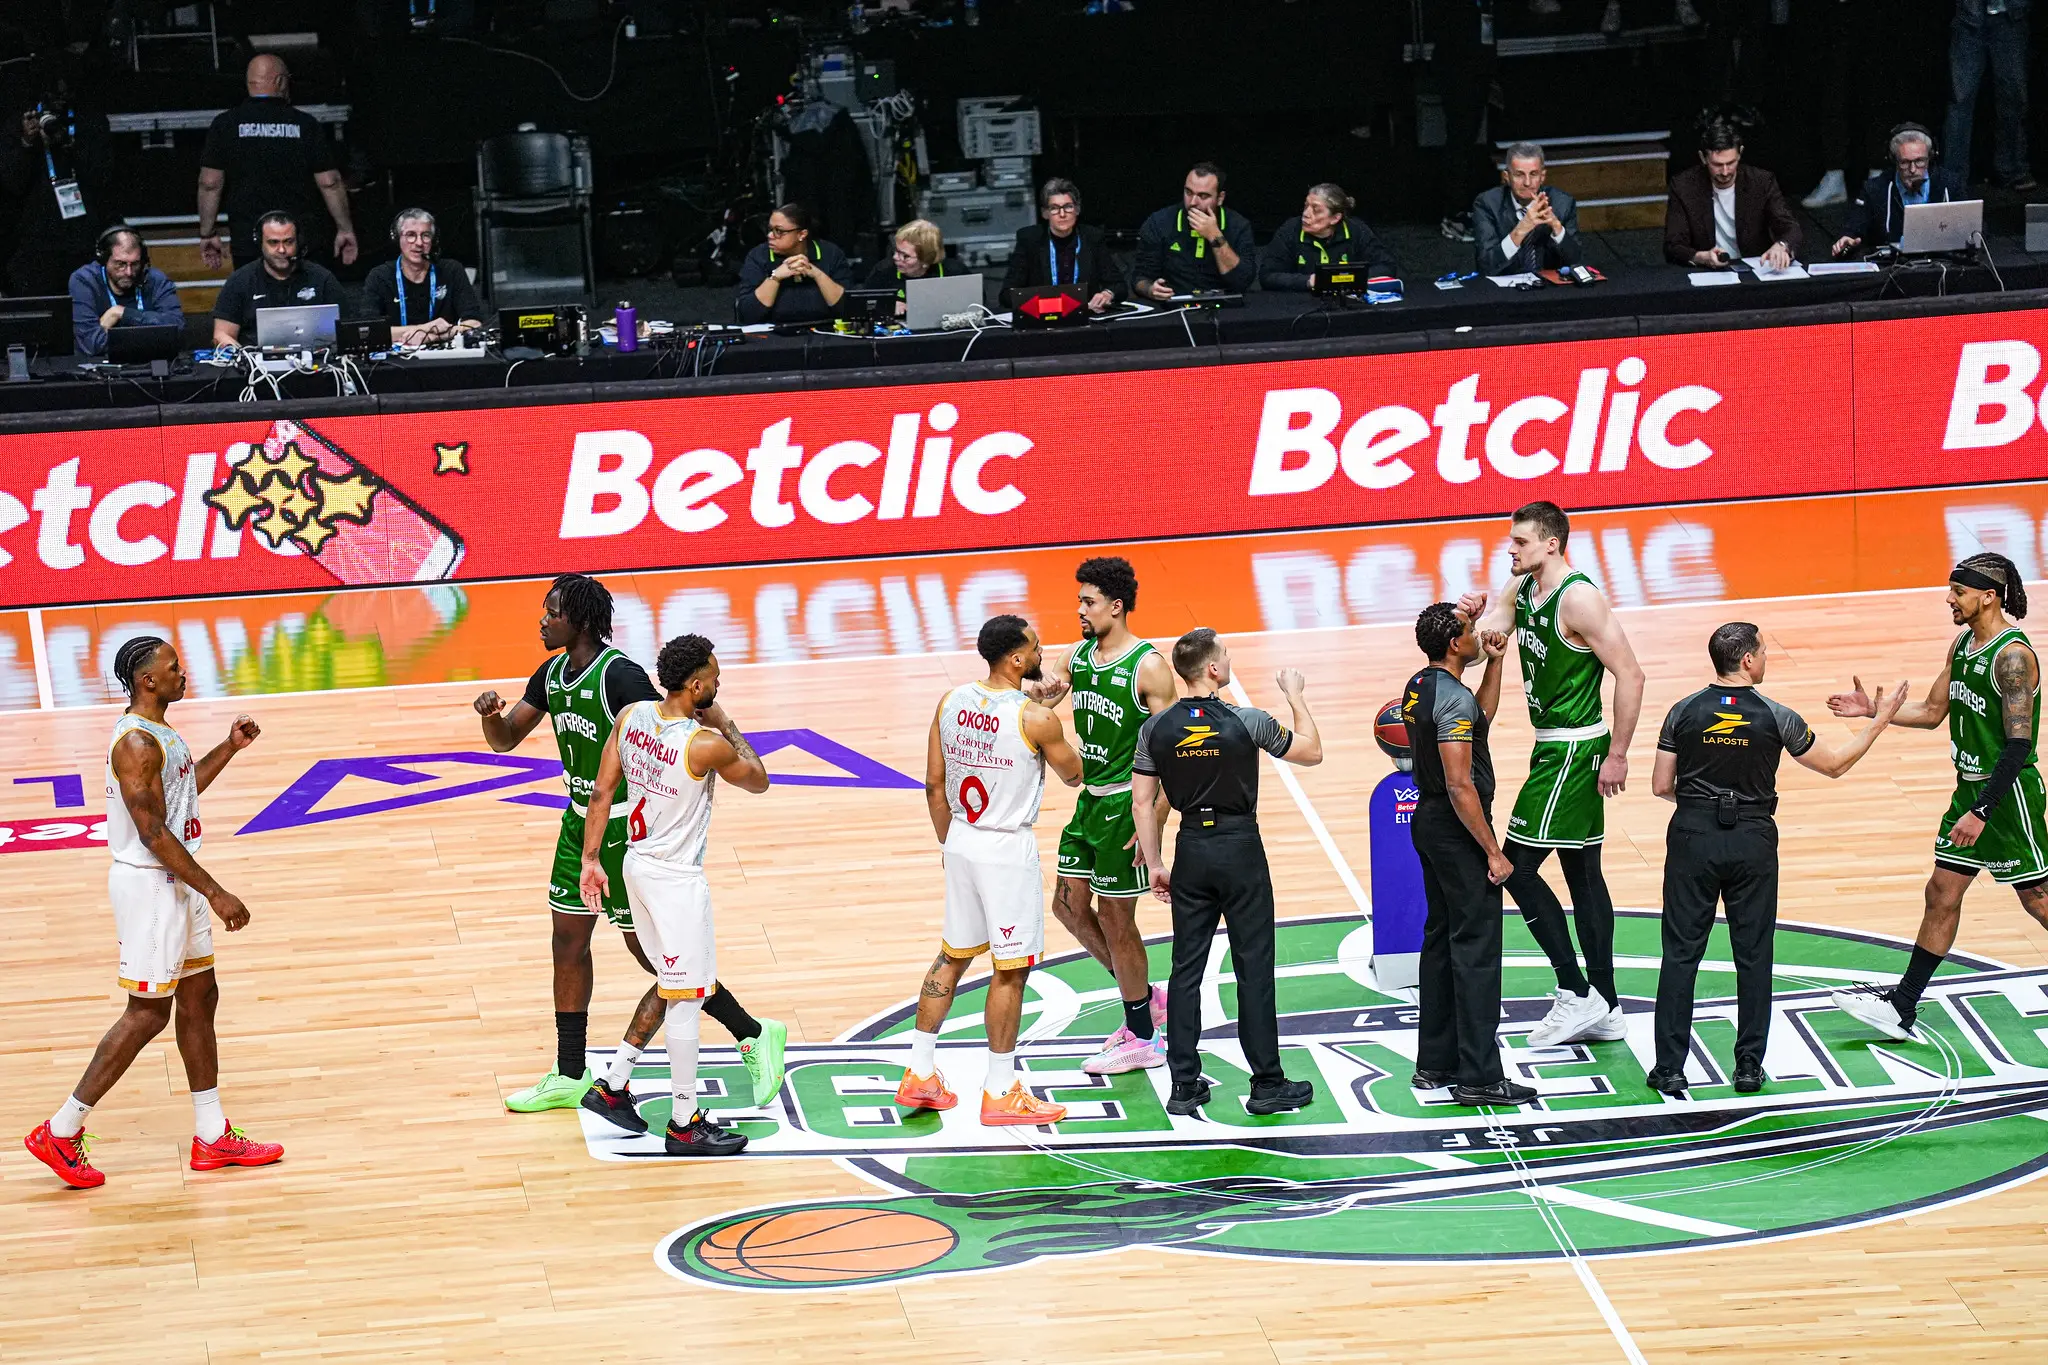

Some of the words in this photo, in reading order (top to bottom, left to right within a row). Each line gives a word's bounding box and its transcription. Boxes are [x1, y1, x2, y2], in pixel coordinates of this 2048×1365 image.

[239, 123, 301, 138] ORGANISATION
[1942, 339, 2048, 450] B
[1248, 356, 1724, 496] Betclic
[558, 402, 1035, 540] Betclic
[0, 441, 303, 570] tcli
[957, 709, 1000, 734] OKOBO
[1087, 714, 1094, 735] 0
[624, 726, 679, 766] MICHINEAU
[956, 733, 994, 752] GROUPE
[1176, 750, 1189, 758] LA
[1190, 749, 1220, 758] POSTE
[1703, 736, 1716, 744] LA
[1717, 737, 1749, 747] POSTE
[567, 744, 573, 767] 1
[976, 750, 1014, 768] PASTOR
[959, 775, 989, 824] 0
[1397, 802, 1418, 811] Betcli
[629, 796, 648, 842] 6
